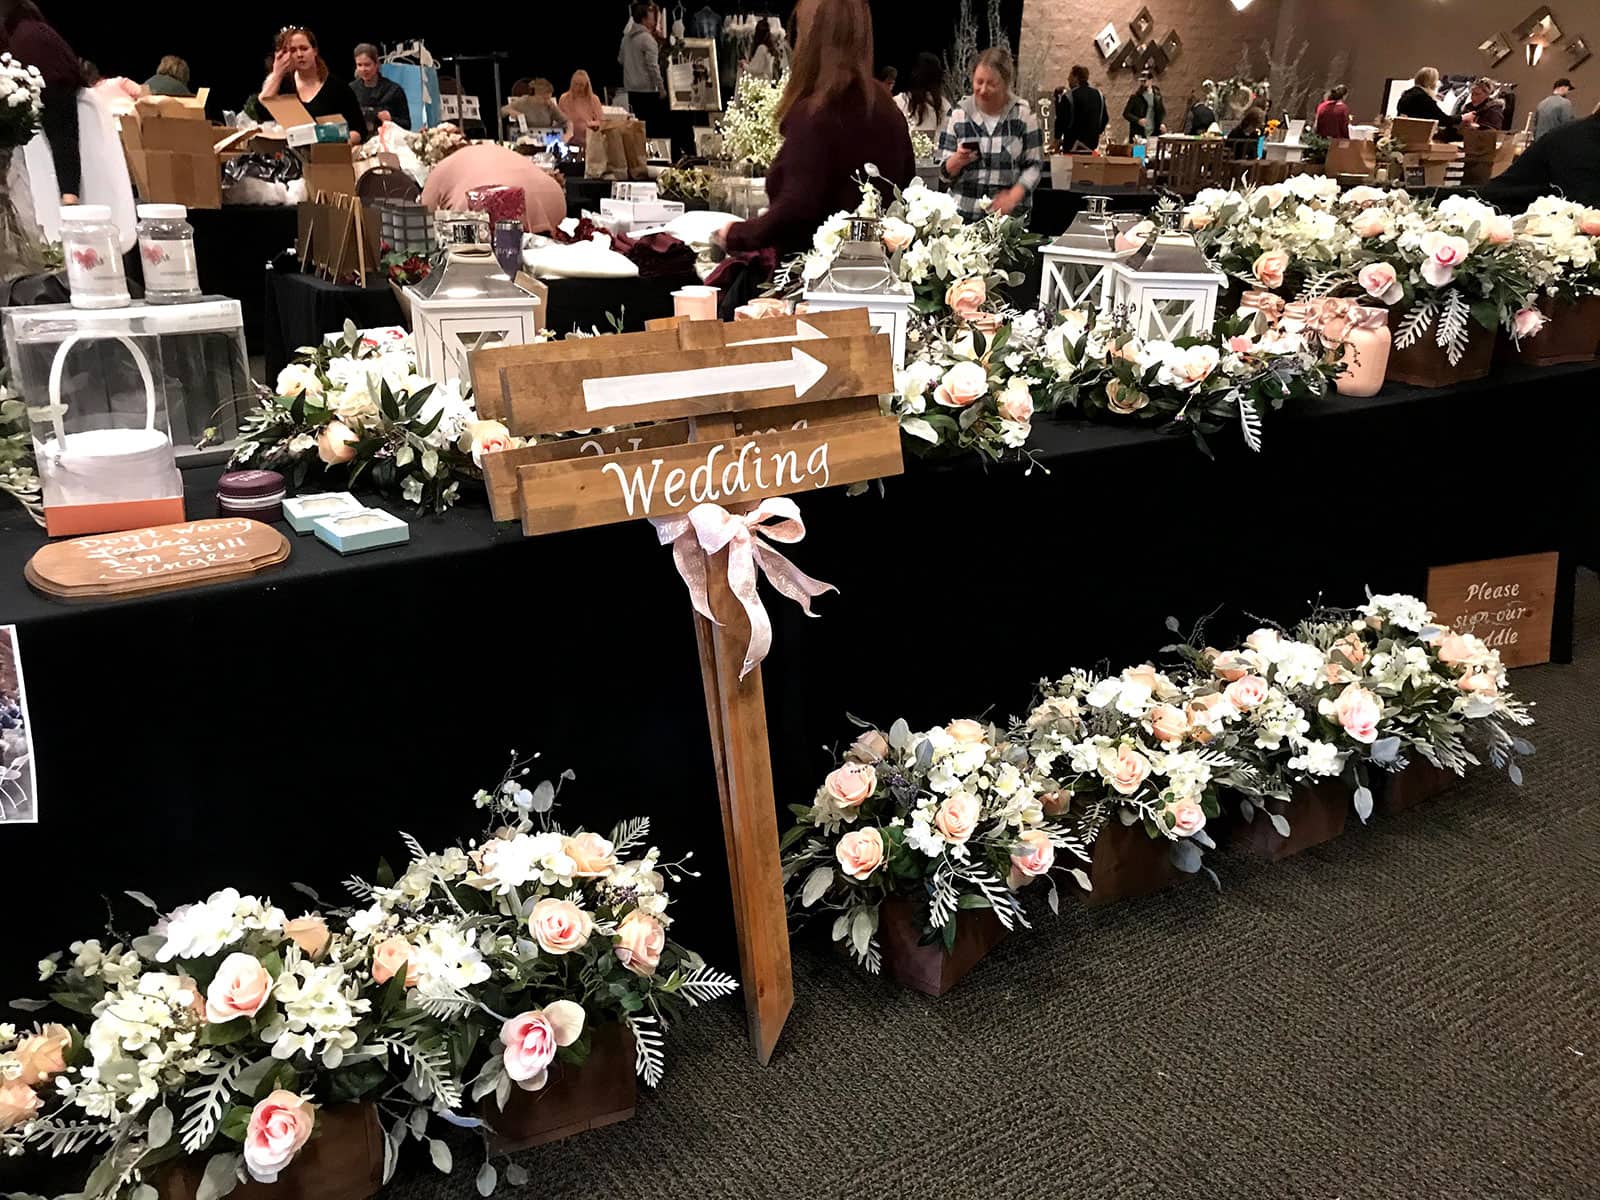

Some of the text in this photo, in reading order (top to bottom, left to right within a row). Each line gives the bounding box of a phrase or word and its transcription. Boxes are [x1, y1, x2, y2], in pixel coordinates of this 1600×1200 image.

[601, 441, 830, 516] Wedding
[172, 519, 251, 535] Worry
[178, 537, 246, 556] Still
[1465, 581, 1520, 602] Please
[1453, 607, 1526, 633] sign our
